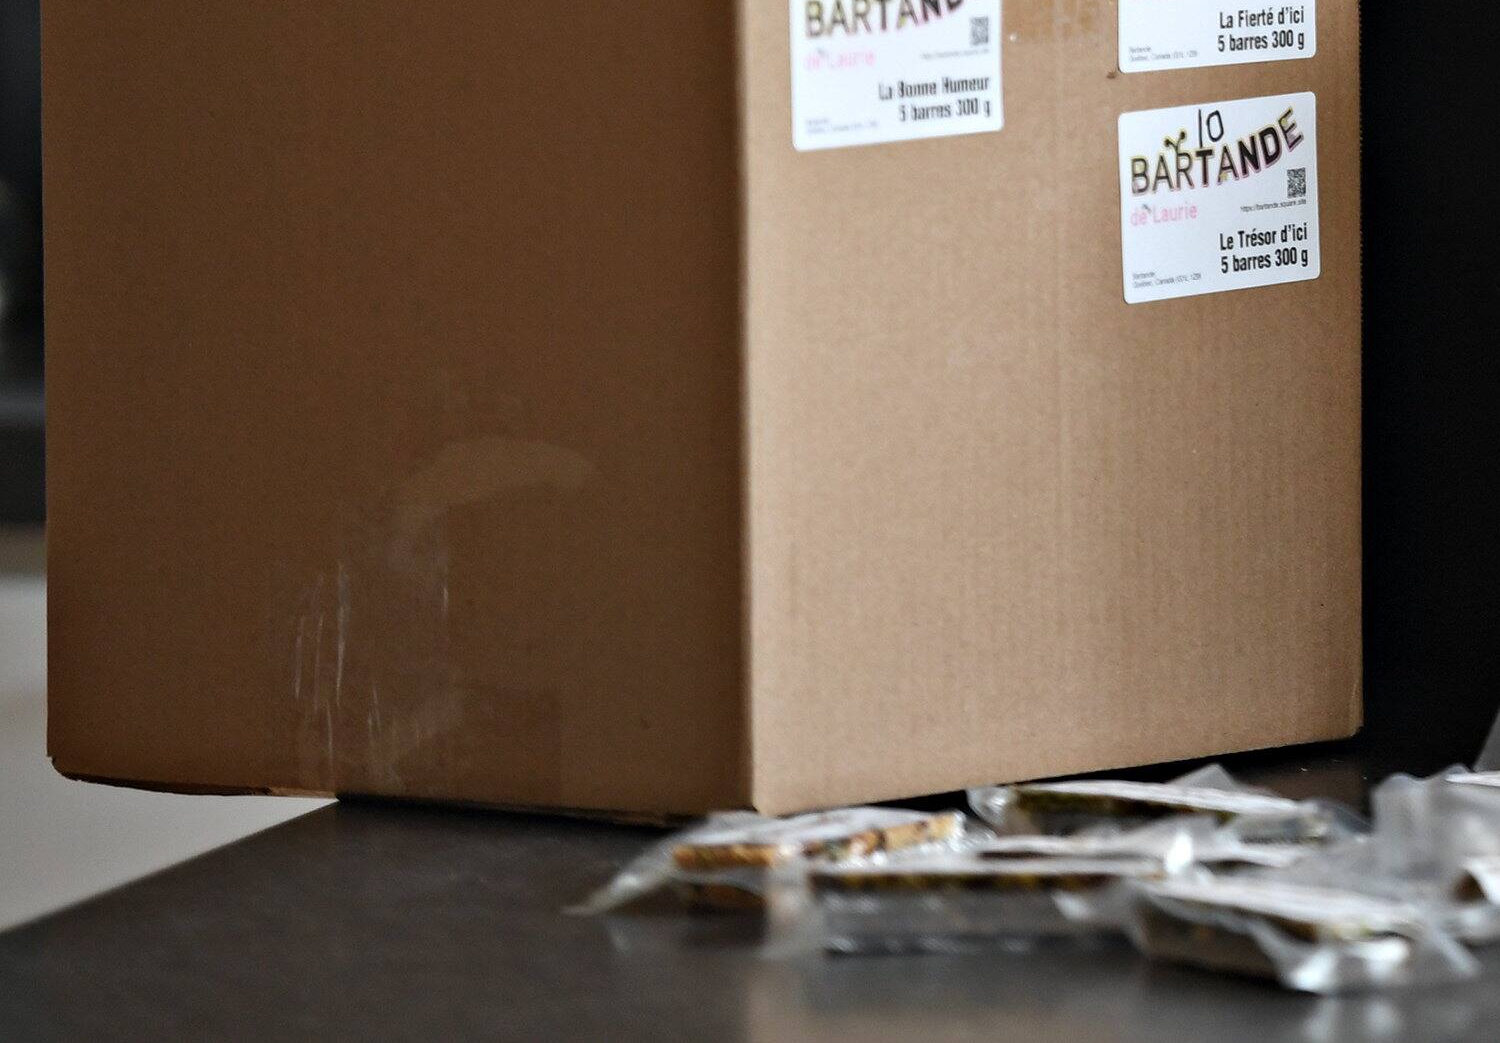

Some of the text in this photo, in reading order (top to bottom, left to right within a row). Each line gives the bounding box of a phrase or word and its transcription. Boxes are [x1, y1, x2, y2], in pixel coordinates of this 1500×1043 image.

[1219, 6, 1305, 29] La Fierté d'ici
[1217, 30, 1305, 53] 5 barres 300 g
[879, 76, 989, 100] La Bonne Humeur
[899, 105, 906, 122] 5
[911, 104, 952, 122] barres
[957, 97, 979, 117] 300
[1198, 109, 1224, 148] 10
[1131, 107, 1304, 195] BARTANDE
[1153, 203, 1198, 224] Laurie
[1219, 223, 1308, 251] Le Trésor d'ici
[1221, 247, 1308, 274] 5 barres 300 g
